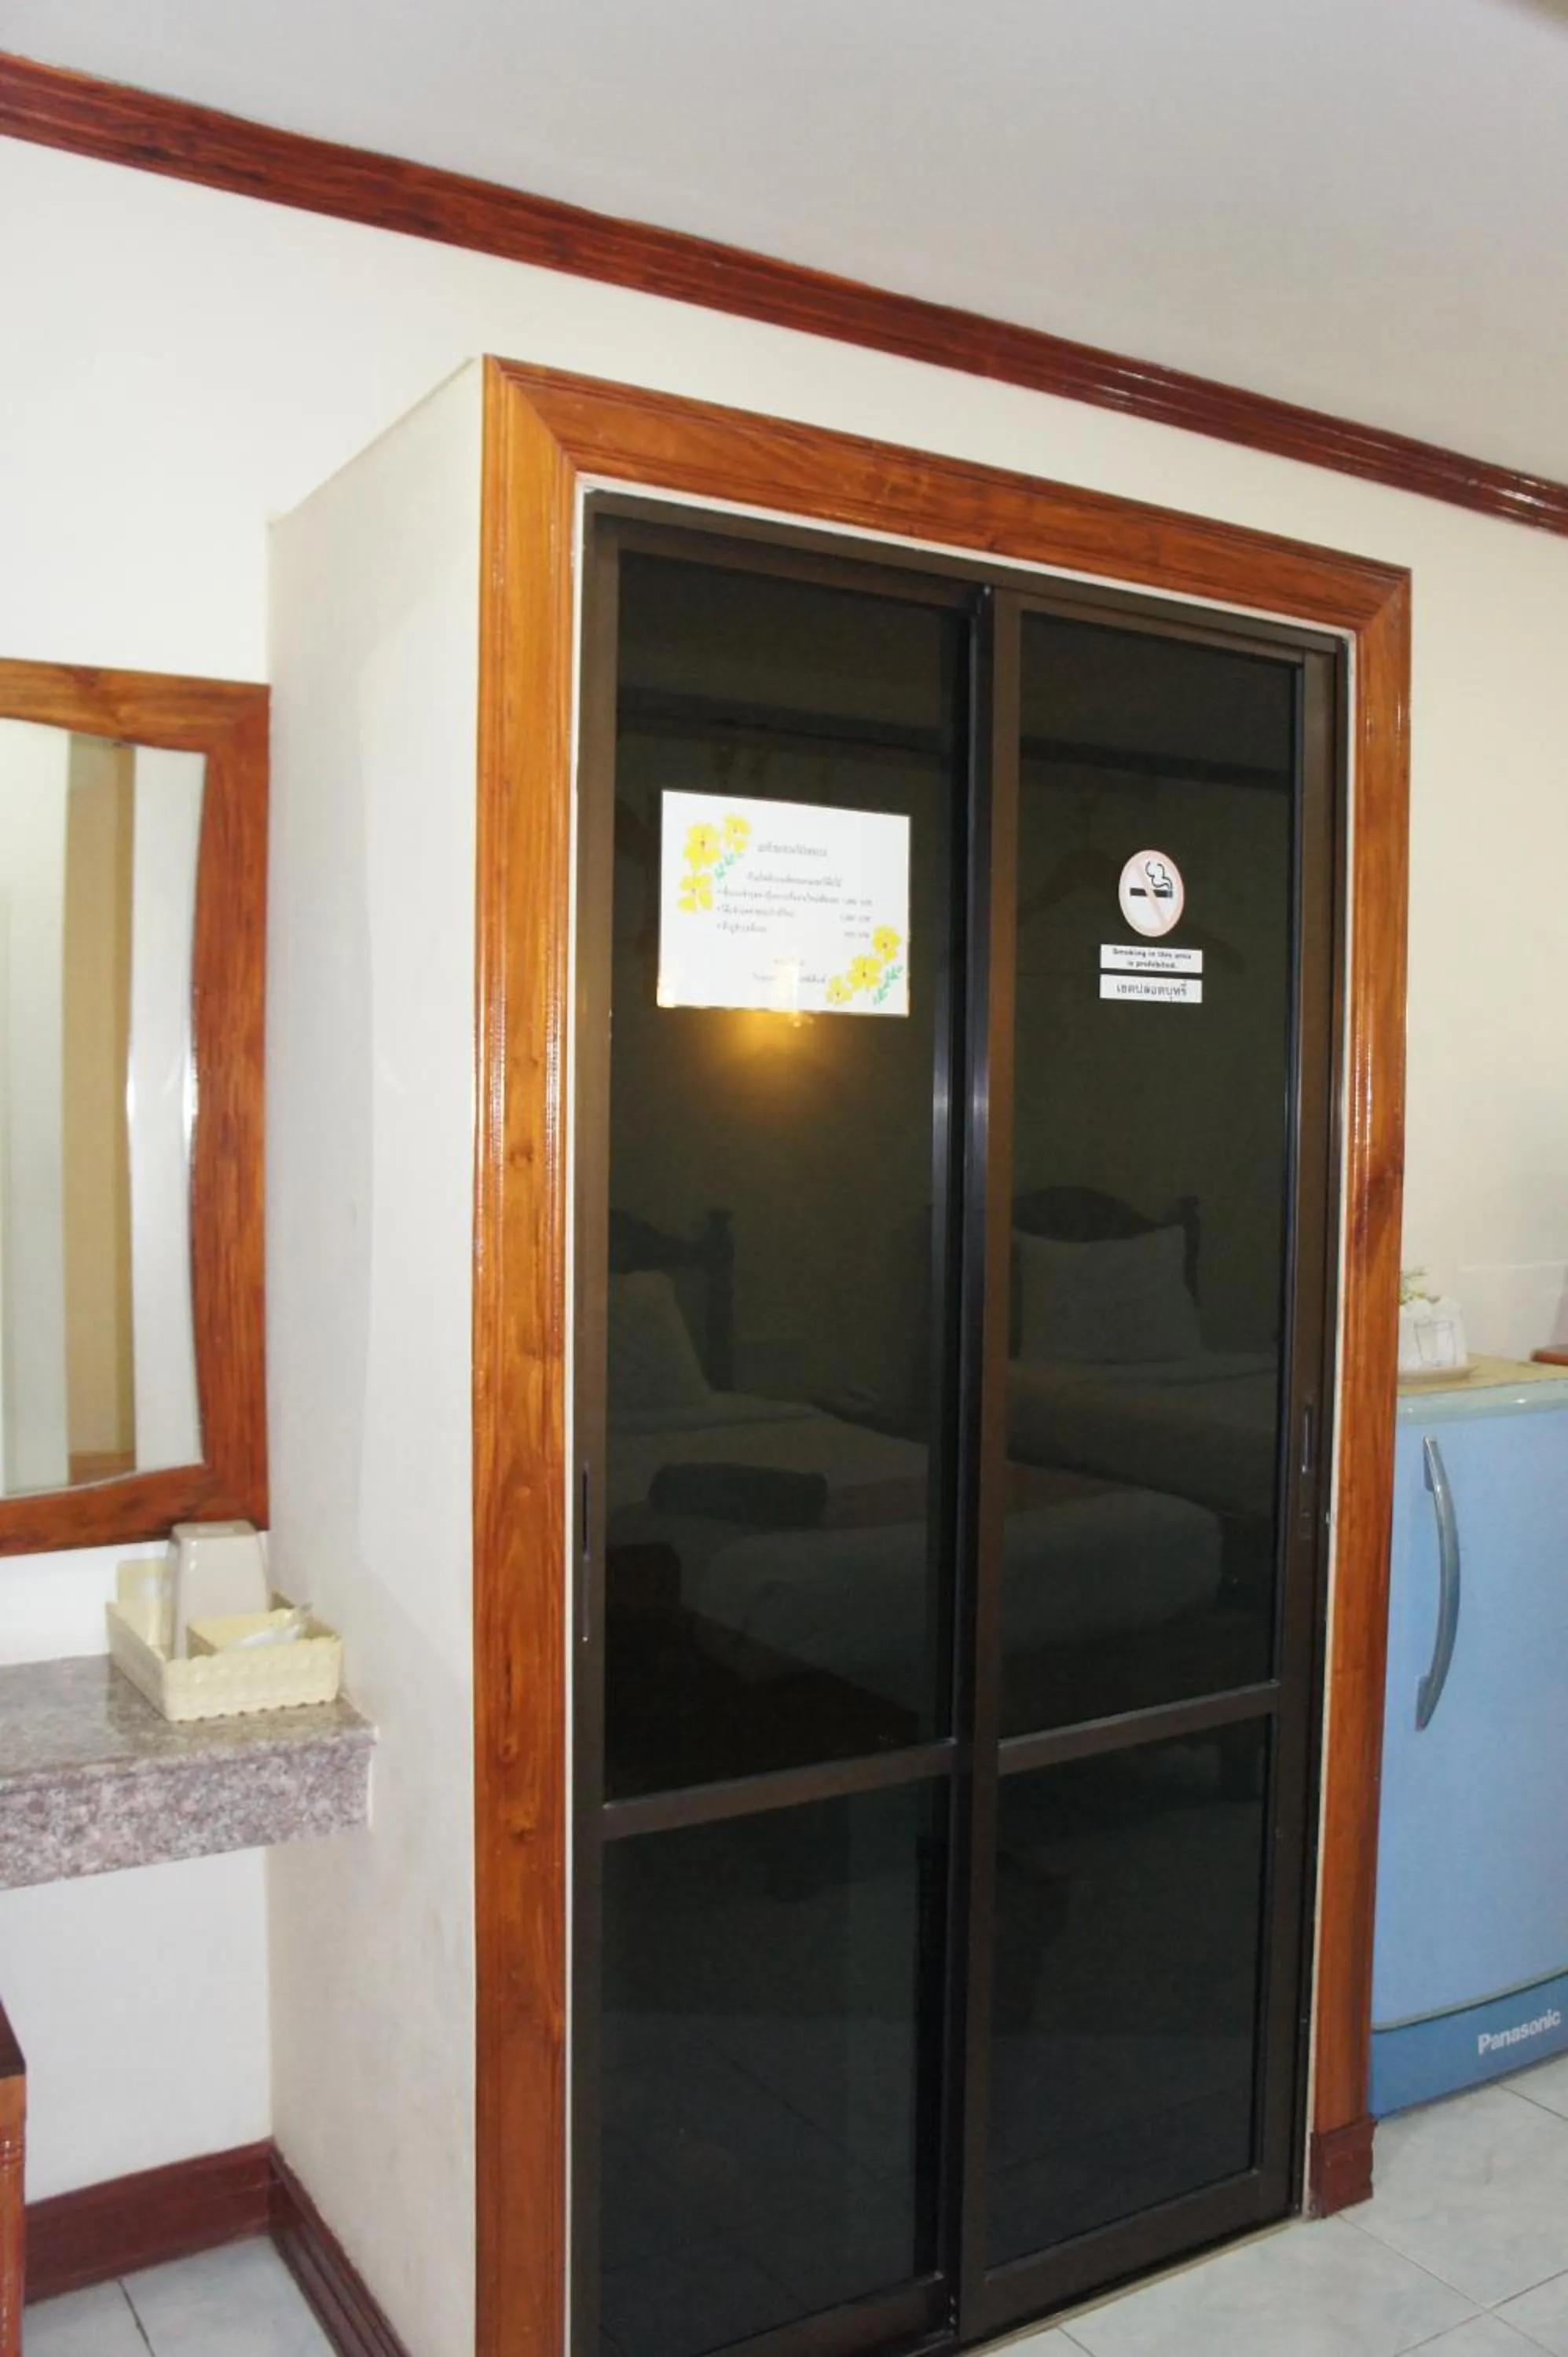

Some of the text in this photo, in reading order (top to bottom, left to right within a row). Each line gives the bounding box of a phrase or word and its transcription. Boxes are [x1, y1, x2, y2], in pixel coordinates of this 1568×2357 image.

[1112, 948, 1146, 959] Smoking
[1157, 950, 1173, 959] this
[1478, 2009, 1561, 2055] Panasonic
